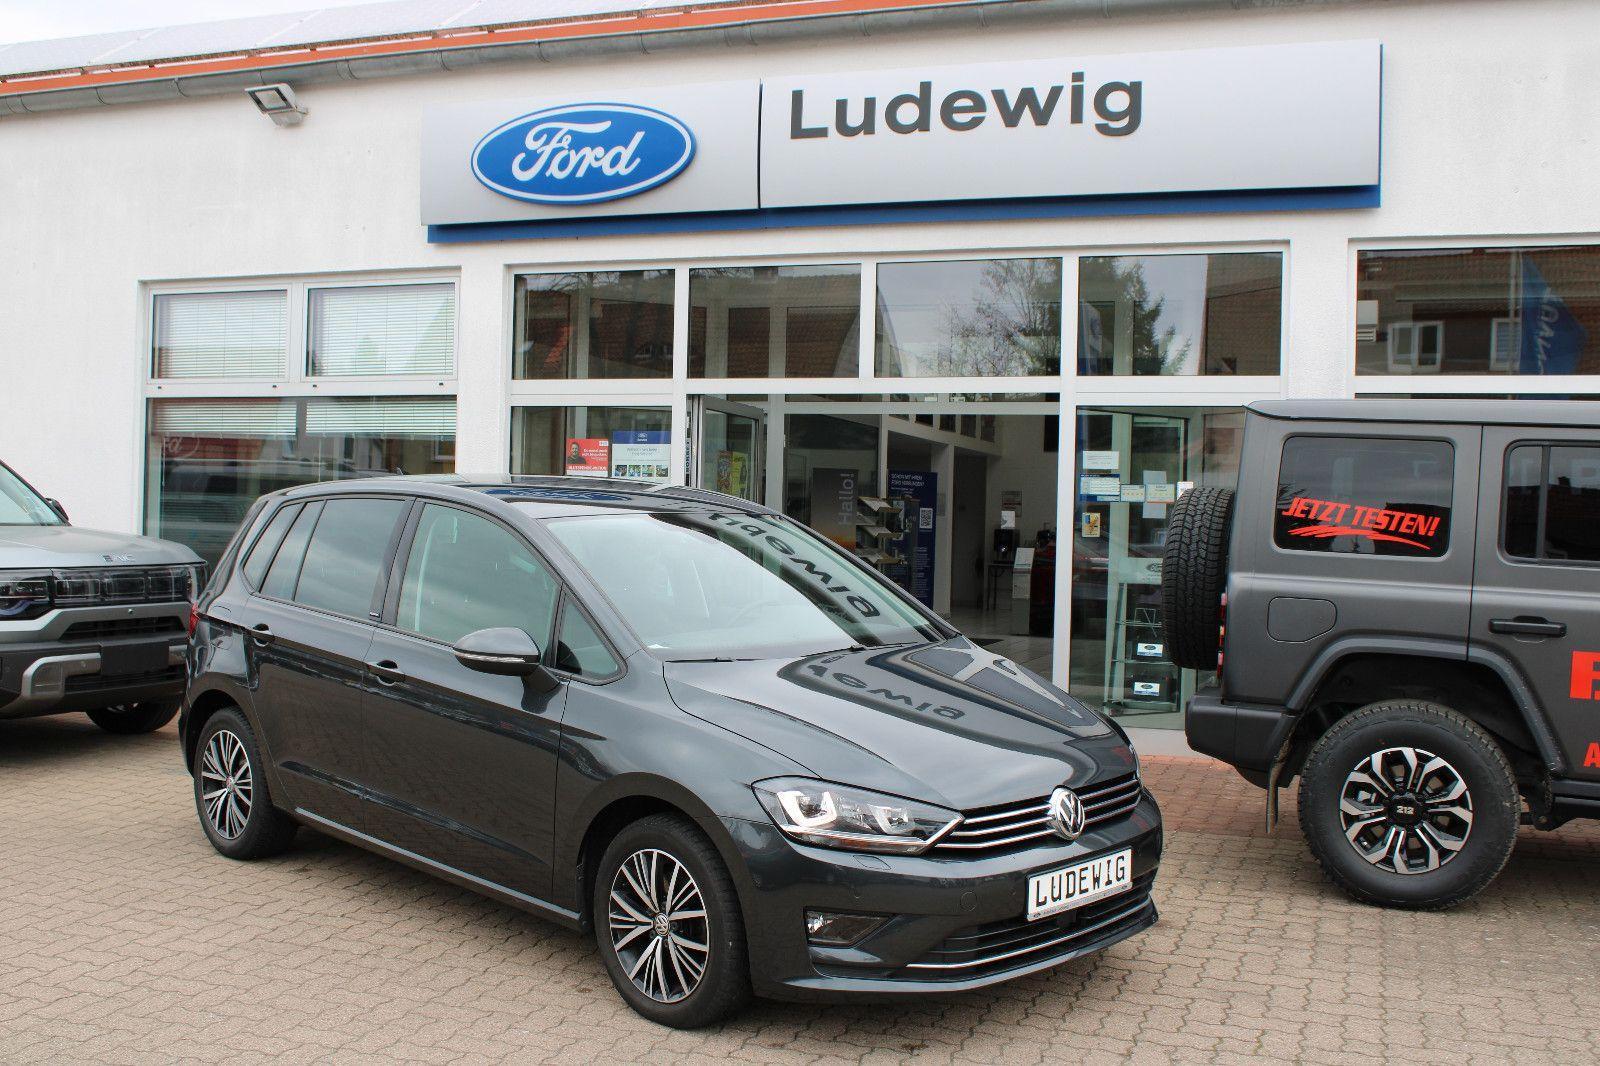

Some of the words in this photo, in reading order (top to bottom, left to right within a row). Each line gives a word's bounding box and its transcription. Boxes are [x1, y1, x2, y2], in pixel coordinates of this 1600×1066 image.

[790, 71, 1143, 139] Ludewig
[511, 120, 646, 182] Ford
[838, 473, 855, 525] Hallo!
[1281, 496, 1352, 523] JETZT
[1352, 505, 1441, 537] TESTEN!
[1035, 855, 1125, 908] LUDEWIG
